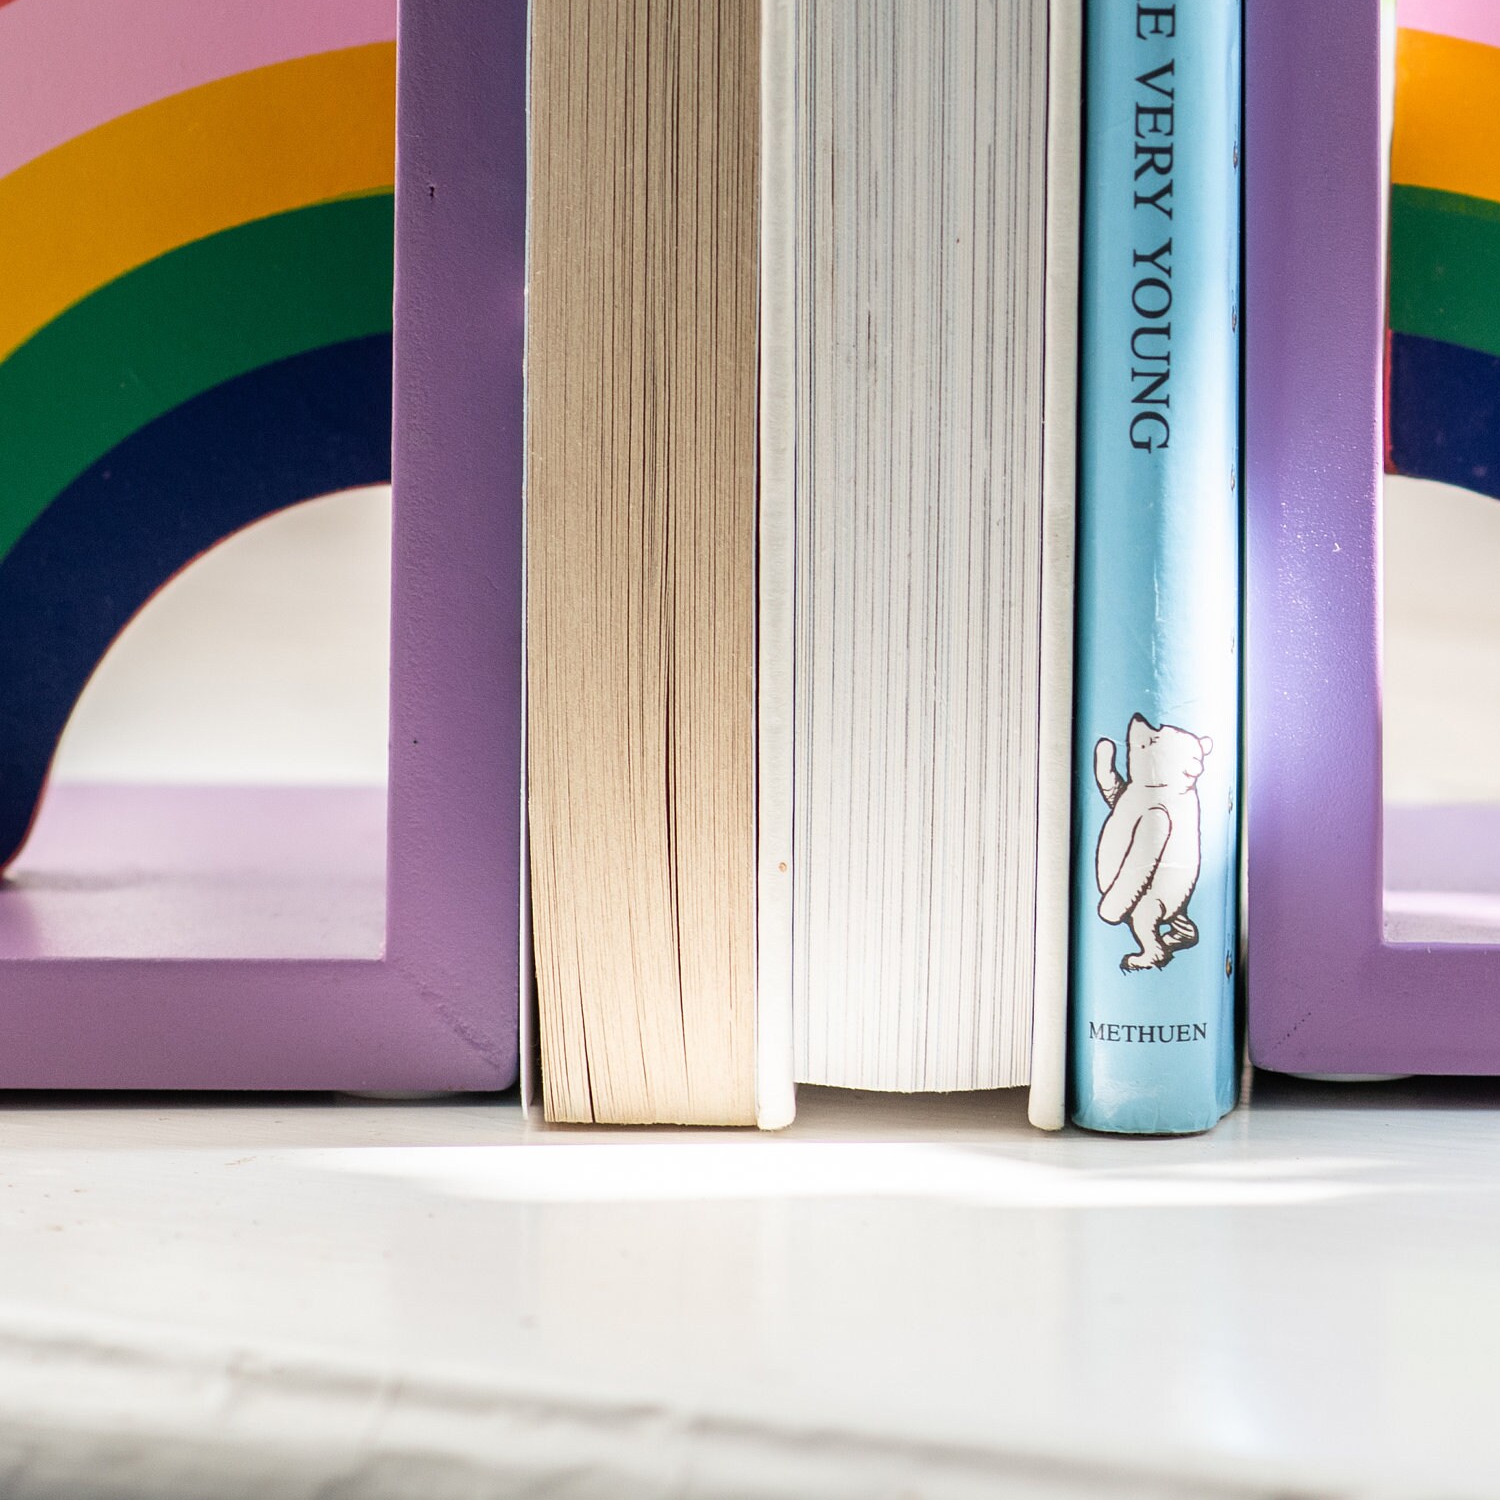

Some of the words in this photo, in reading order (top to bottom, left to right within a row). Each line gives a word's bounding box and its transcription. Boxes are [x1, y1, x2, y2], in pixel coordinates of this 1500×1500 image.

[1132, 57, 1176, 221] VERY
[1128, 236, 1173, 455] YOUNG
[1088, 1020, 1209, 1044] METHUEN
